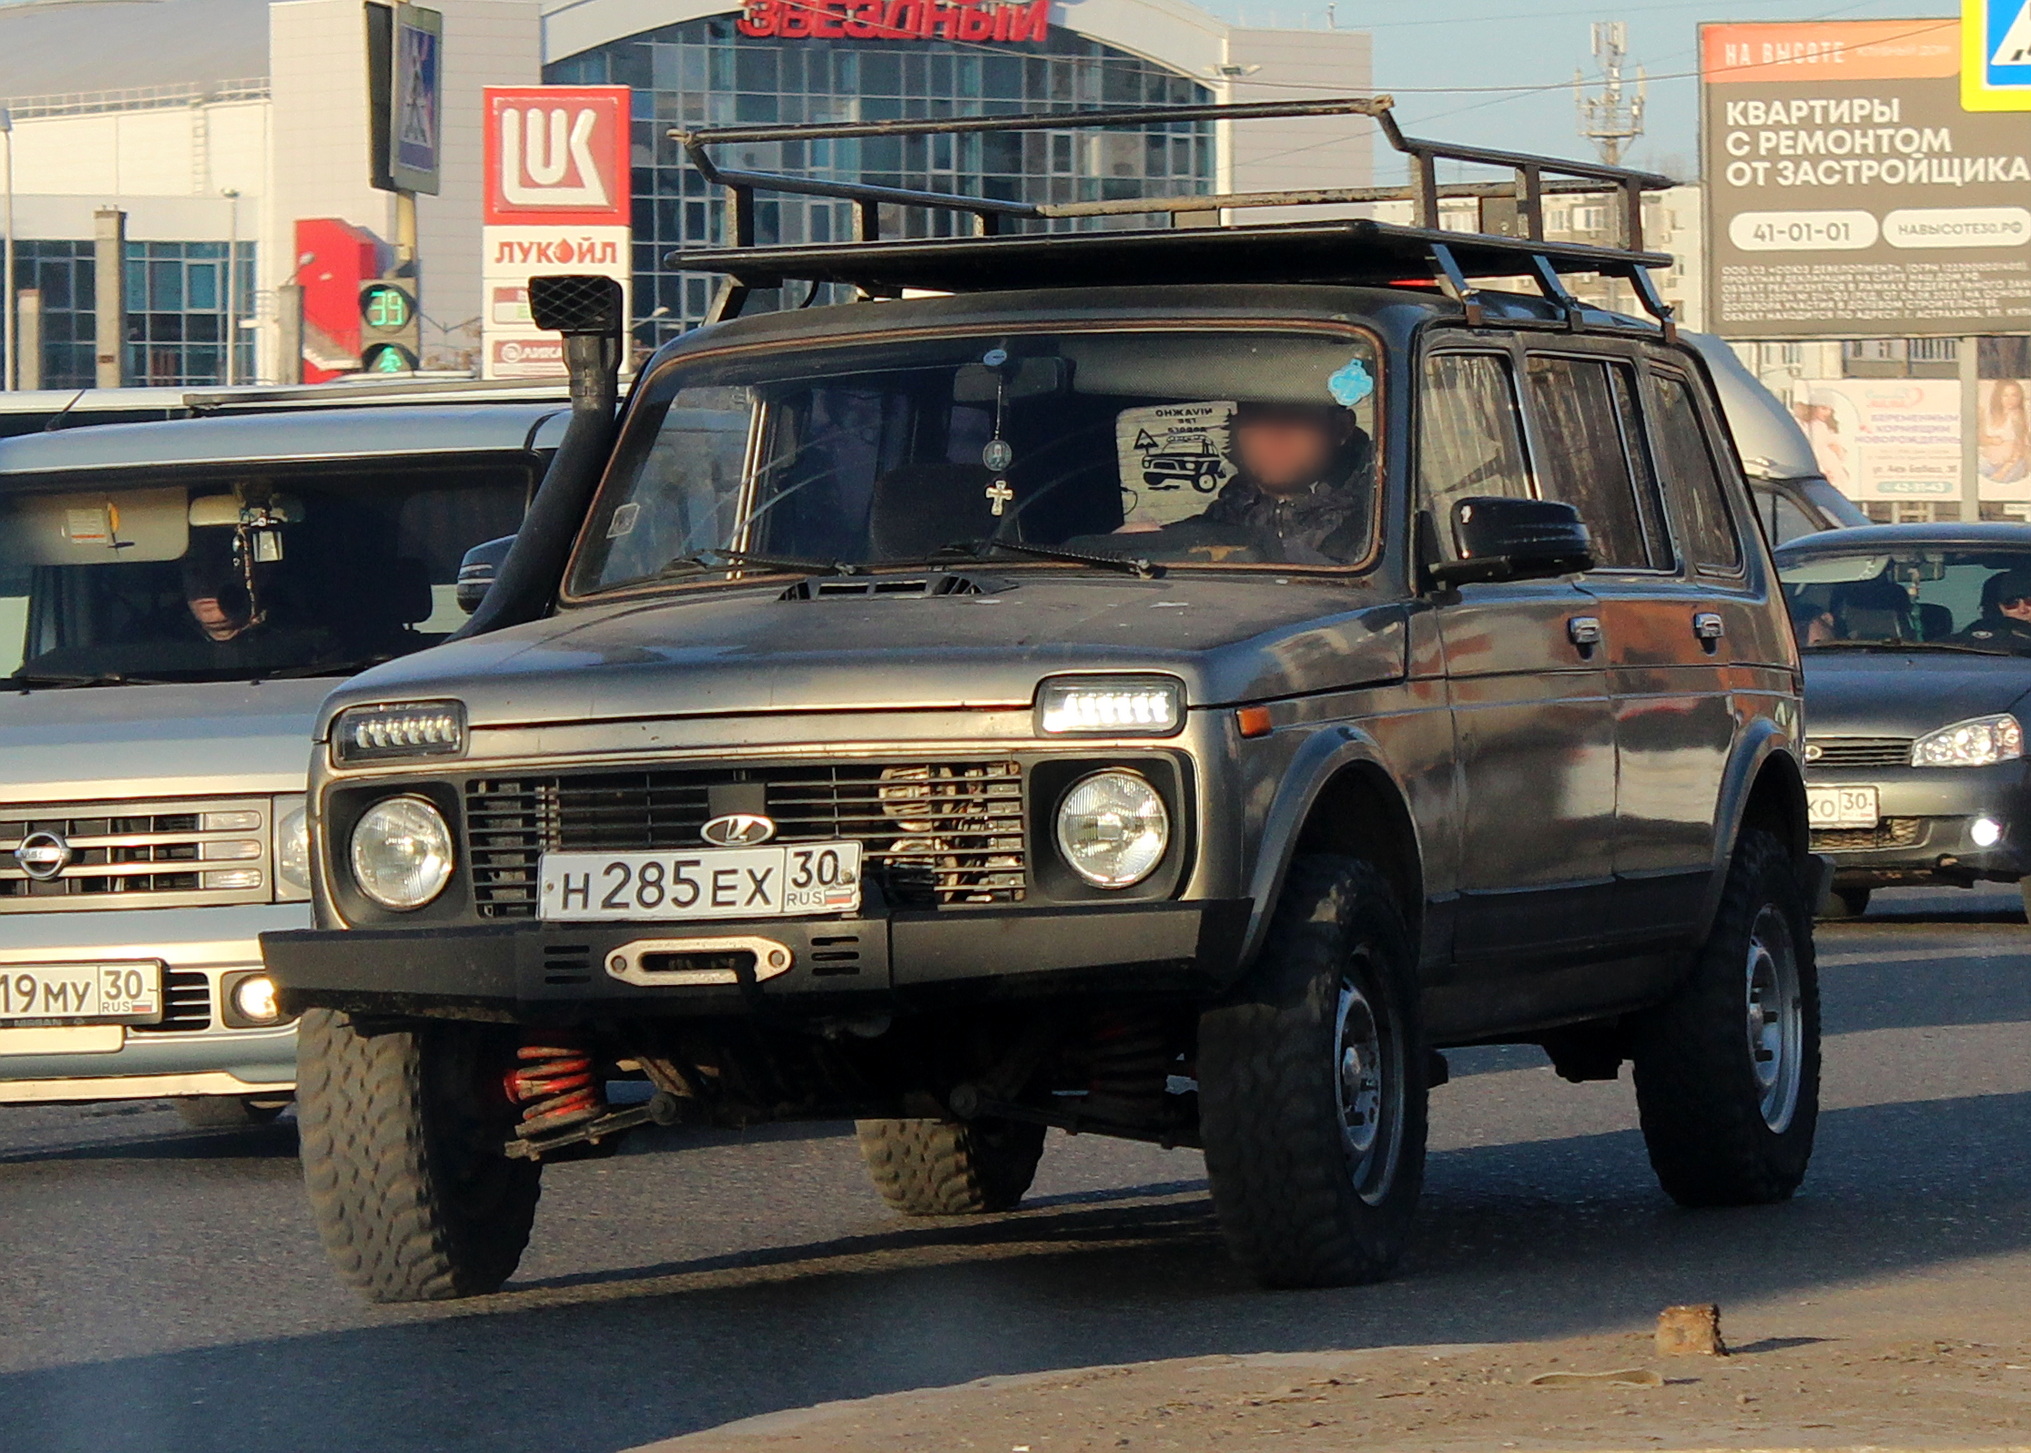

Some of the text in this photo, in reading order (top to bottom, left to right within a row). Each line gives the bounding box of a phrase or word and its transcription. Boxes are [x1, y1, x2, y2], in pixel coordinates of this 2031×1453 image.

[1725, 43, 1751, 65] НА
[1762, 42, 1846, 64] ВЫСОТЕ
[1726, 98, 1900, 125] КВАРТИРЫ
[1726, 128, 1952, 156] С РЕМОНТОМ
[1726, 153, 2031, 186] ОТ ЗАСТРОЙЩИКА
[1753, 222, 1850, 243] 41-01-01
[1898, 221, 2023, 235] НАВЫСОТЕ30.РФ
[495, 237, 617, 263] ЛУКОЙЛ
[371, 291, 403, 326] 39
[1842, 792, 1868, 811] 30
[561, 849, 840, 911] Н285ЕХ 30
[786, 891, 822, 907] RUS
[104, 969, 143, 1000] 30
[102, 1001, 130, 1013] RUS
